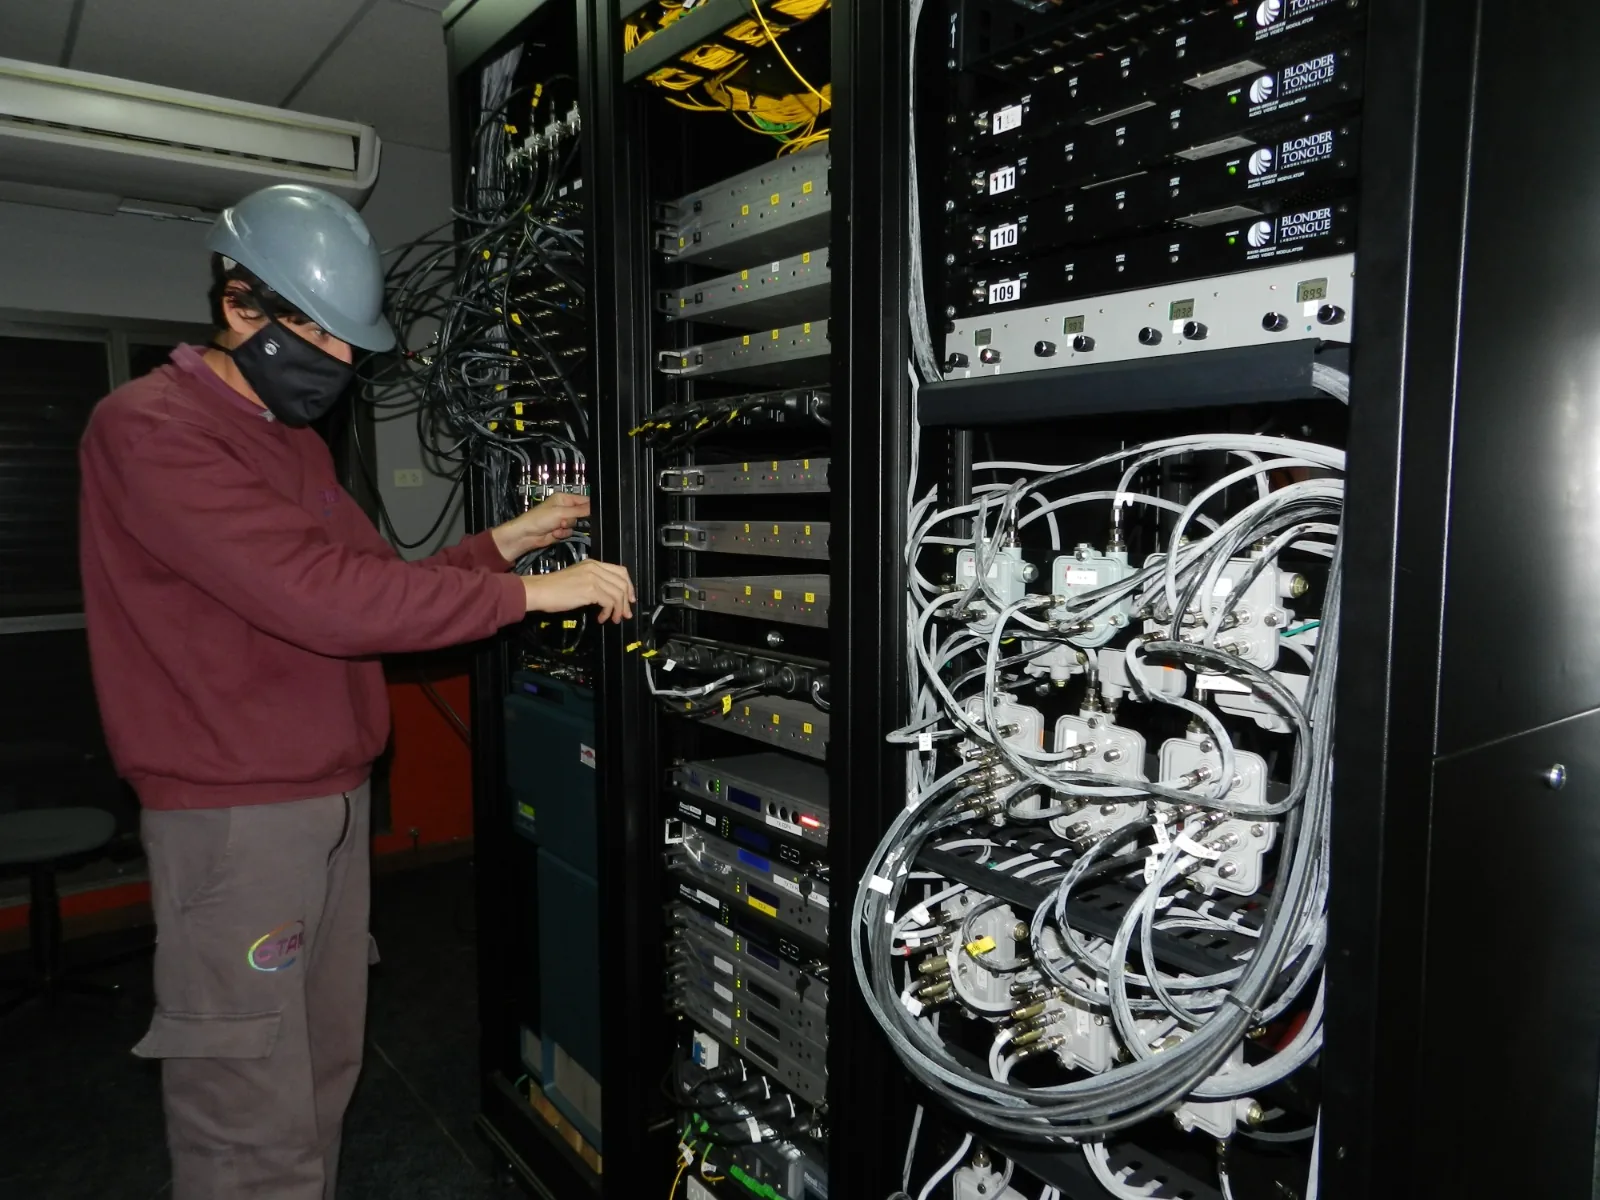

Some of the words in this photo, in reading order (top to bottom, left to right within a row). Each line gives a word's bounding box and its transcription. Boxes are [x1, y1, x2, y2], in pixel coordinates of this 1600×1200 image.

[1285, 16, 1314, 30] MODULATOR
[1284, 54, 1334, 79] BLONDER
[1283, 66, 1334, 90] TONGUE
[1278, 96, 1307, 109] MODULATOR
[1282, 130, 1332, 152] BLONDER
[1282, 142, 1332, 164] TONGUE
[993, 171, 1014, 191] 111
[1277, 172, 1305, 182] MODULATOR
[1282, 208, 1331, 226] BLONDER
[1280, 219, 1331, 238] TONGUE
[994, 229, 1014, 247] 110
[1276, 246, 1304, 255] MODULATOR
[992, 285, 1014, 302] 109
